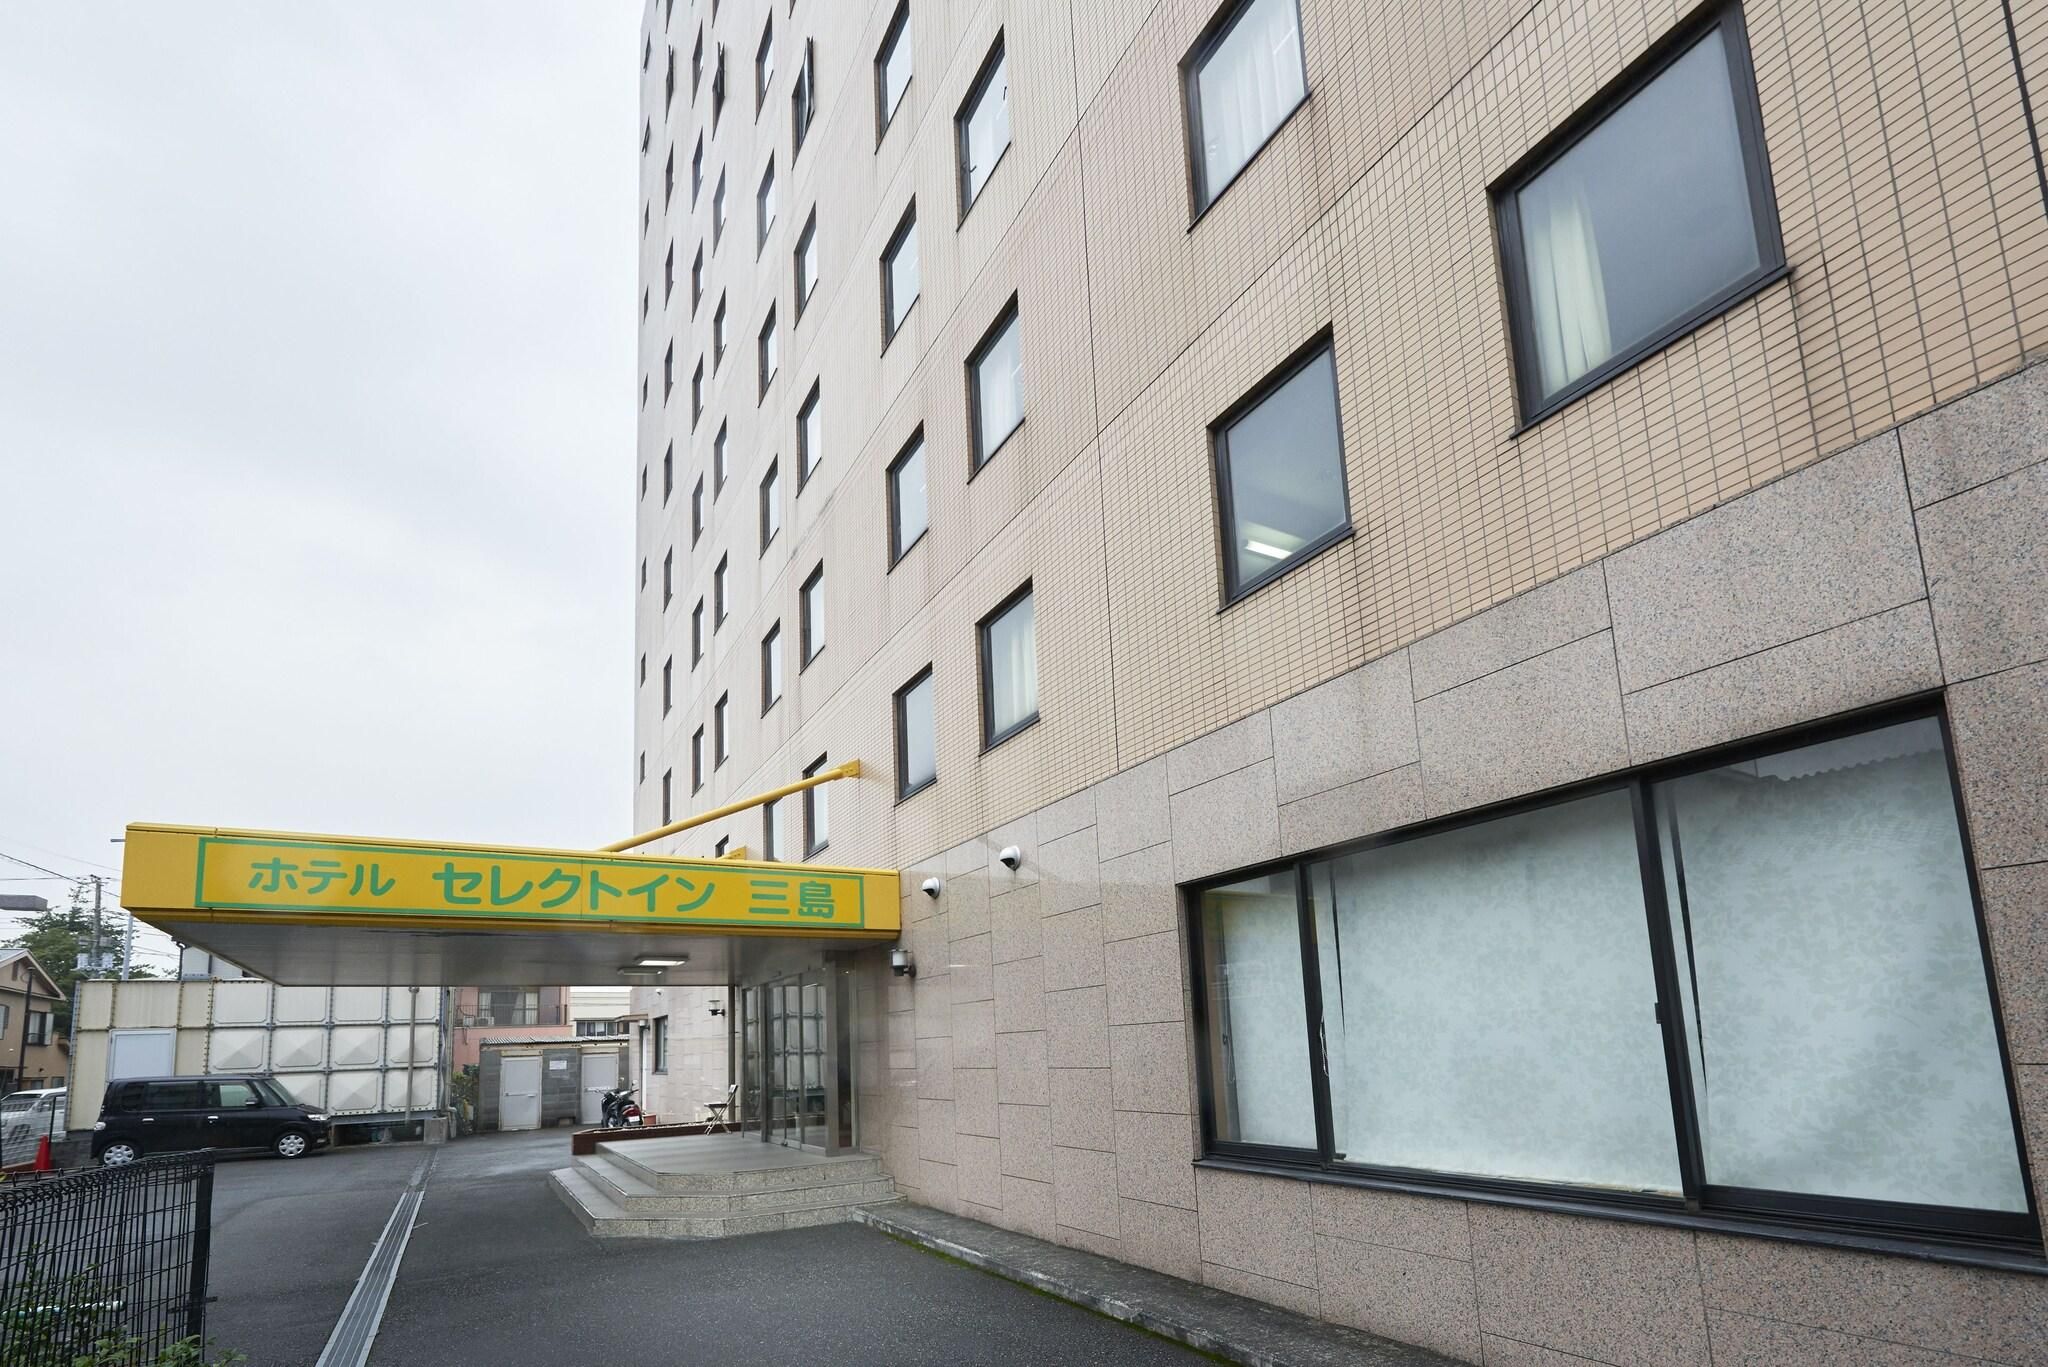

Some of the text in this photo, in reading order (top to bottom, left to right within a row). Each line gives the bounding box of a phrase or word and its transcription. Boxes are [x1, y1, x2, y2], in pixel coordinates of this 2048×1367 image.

[248, 857, 835, 920] ホテル セレクトイン 三島
